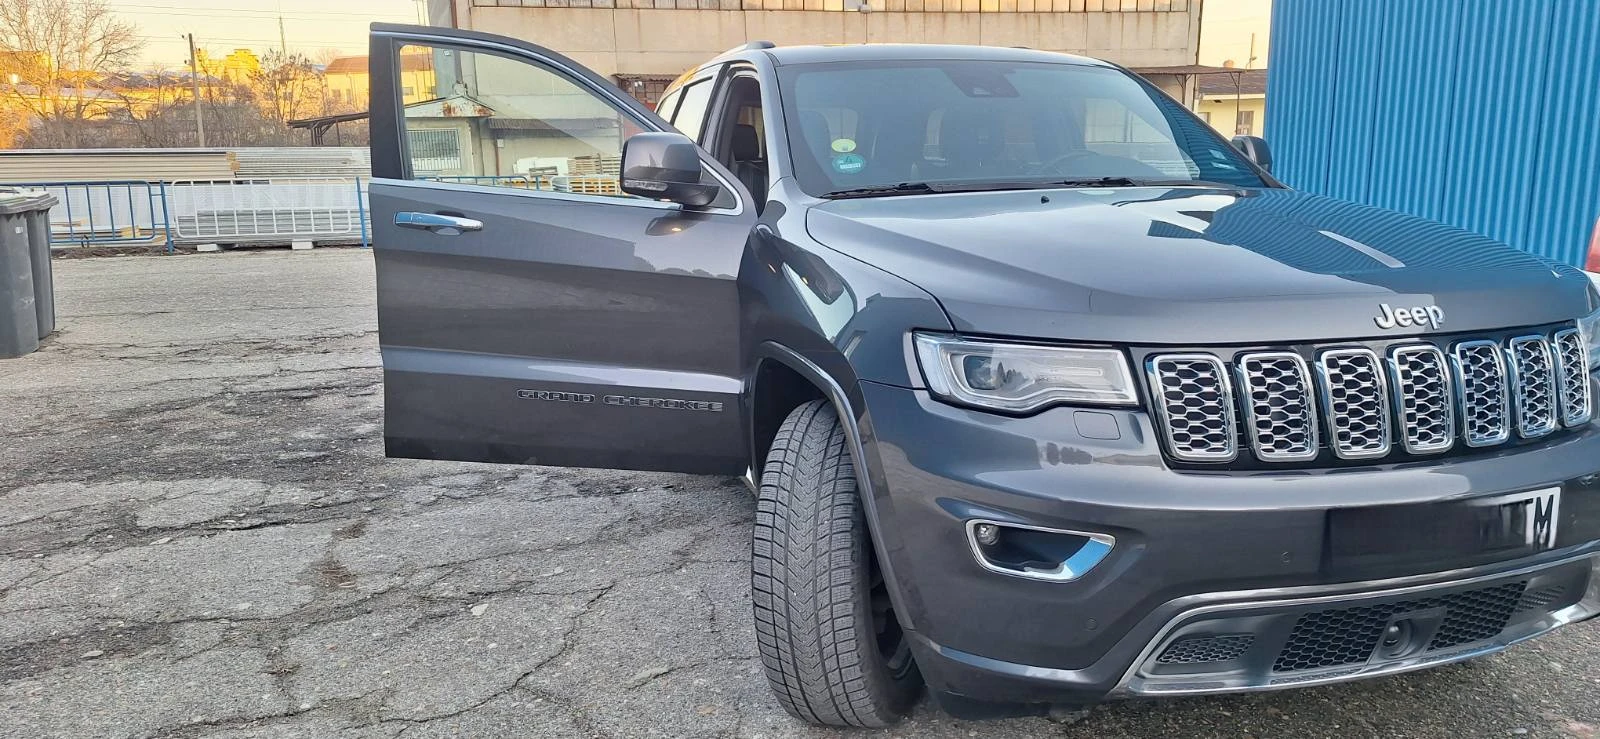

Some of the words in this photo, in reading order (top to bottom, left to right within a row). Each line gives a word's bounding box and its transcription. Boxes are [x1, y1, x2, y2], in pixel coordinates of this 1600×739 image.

[1374, 303, 1444, 330] Jeep
[517, 388, 595, 403] GRAND
[603, 395, 723, 412] CHEROKEE
